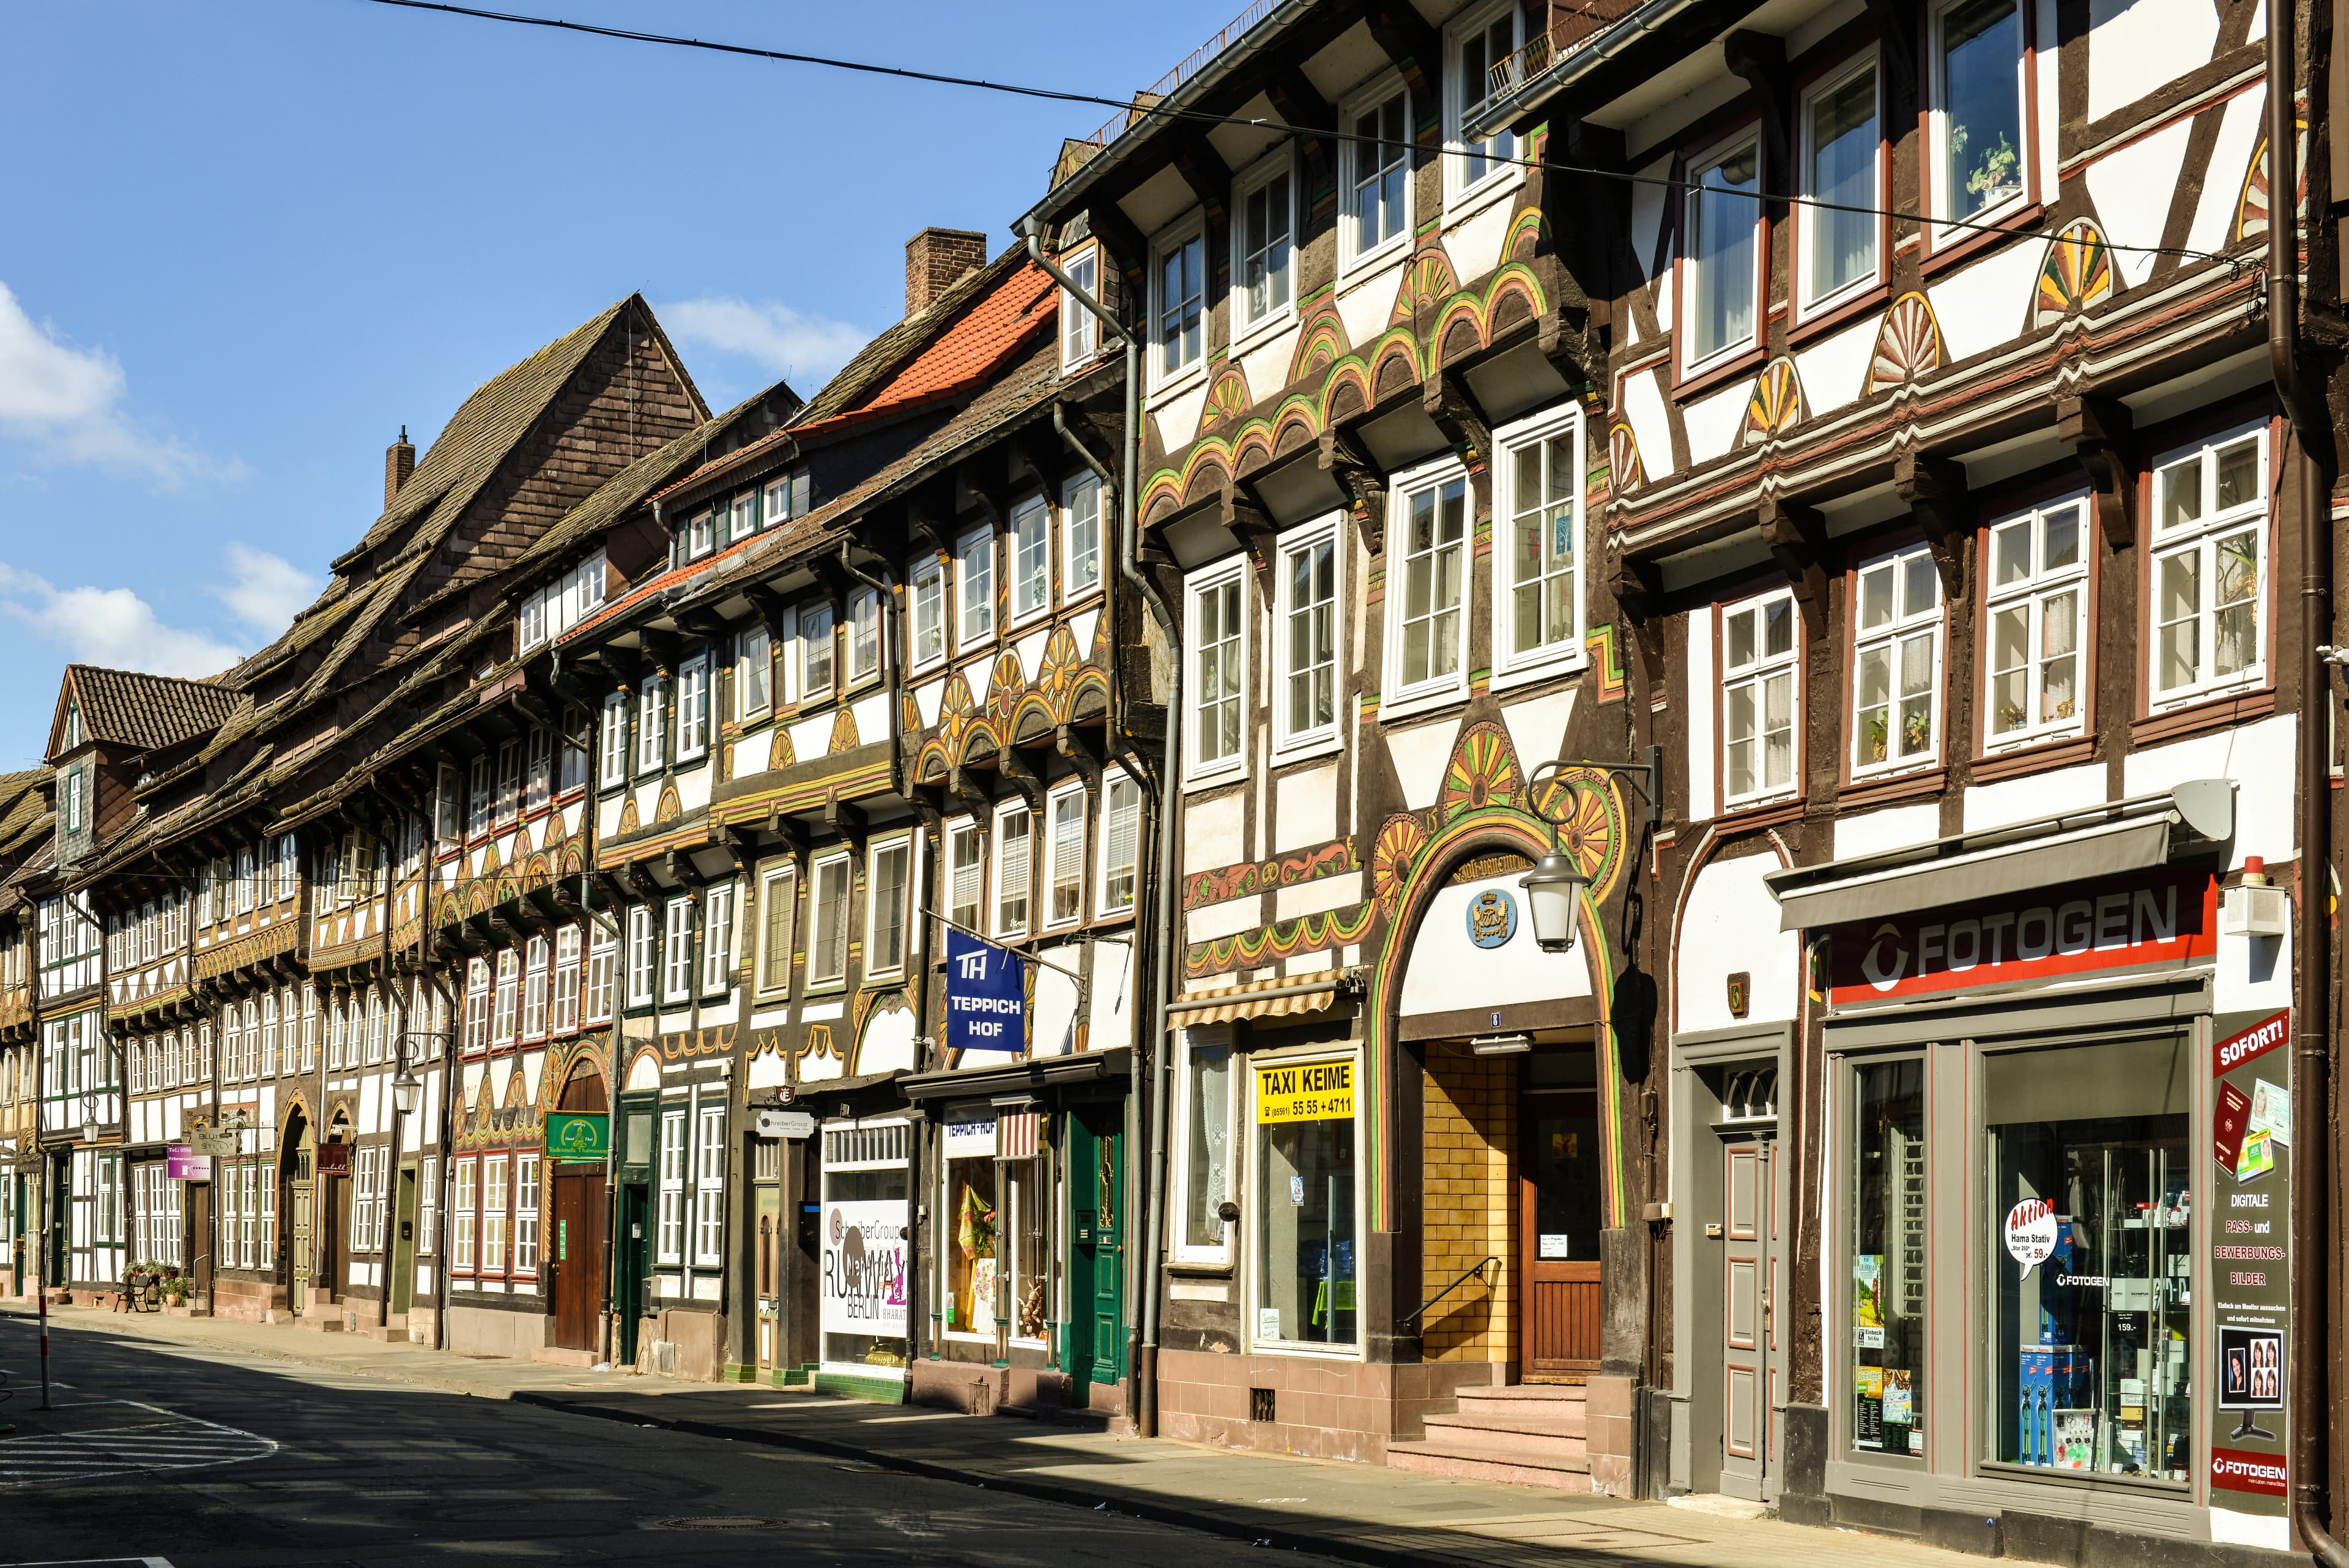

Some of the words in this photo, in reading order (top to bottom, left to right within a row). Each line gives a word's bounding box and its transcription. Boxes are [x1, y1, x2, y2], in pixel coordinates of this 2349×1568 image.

[1918, 885, 2177, 979] FOTOGEN
[956, 949, 987, 980] TH
[951, 995, 1020, 1014] TEPPICH
[969, 1020, 1003, 1037] HOF
[1493, 1014, 1497, 1026] 8
[2221, 1020, 2283, 1066] SOFORT!
[1263, 1071, 1296, 1095] TAXI
[1303, 1065, 1350, 1092] KEIME
[1272, 1107, 1290, 1118] (05561)
[1293, 1101, 1304, 1115] 55
[1307, 1099, 1318, 1114] 55
[1328, 1097, 1351, 1113] 4711
[2231, 1194, 2269, 1207] DIGITALE
[2011, 1198, 2054, 1231] Aktion
[2226, 1221, 2252, 1233] PASS-
[2255, 1221, 2269, 1233] und
[2011, 1234, 2030, 1243] Hama
[2032, 1234, 2050, 1243] Stativ
[2035, 1249, 2048, 1258] 59.-
[2214, 1246, 2285, 1260] BEWERBUNGS-
[2066, 1276, 2110, 1286] FOTOGEN
[2230, 1273, 2266, 1285] BILDER
[848, 1294, 879, 1320] BERLIN
[2226, 1461, 2286, 1480] FOTOGEN
